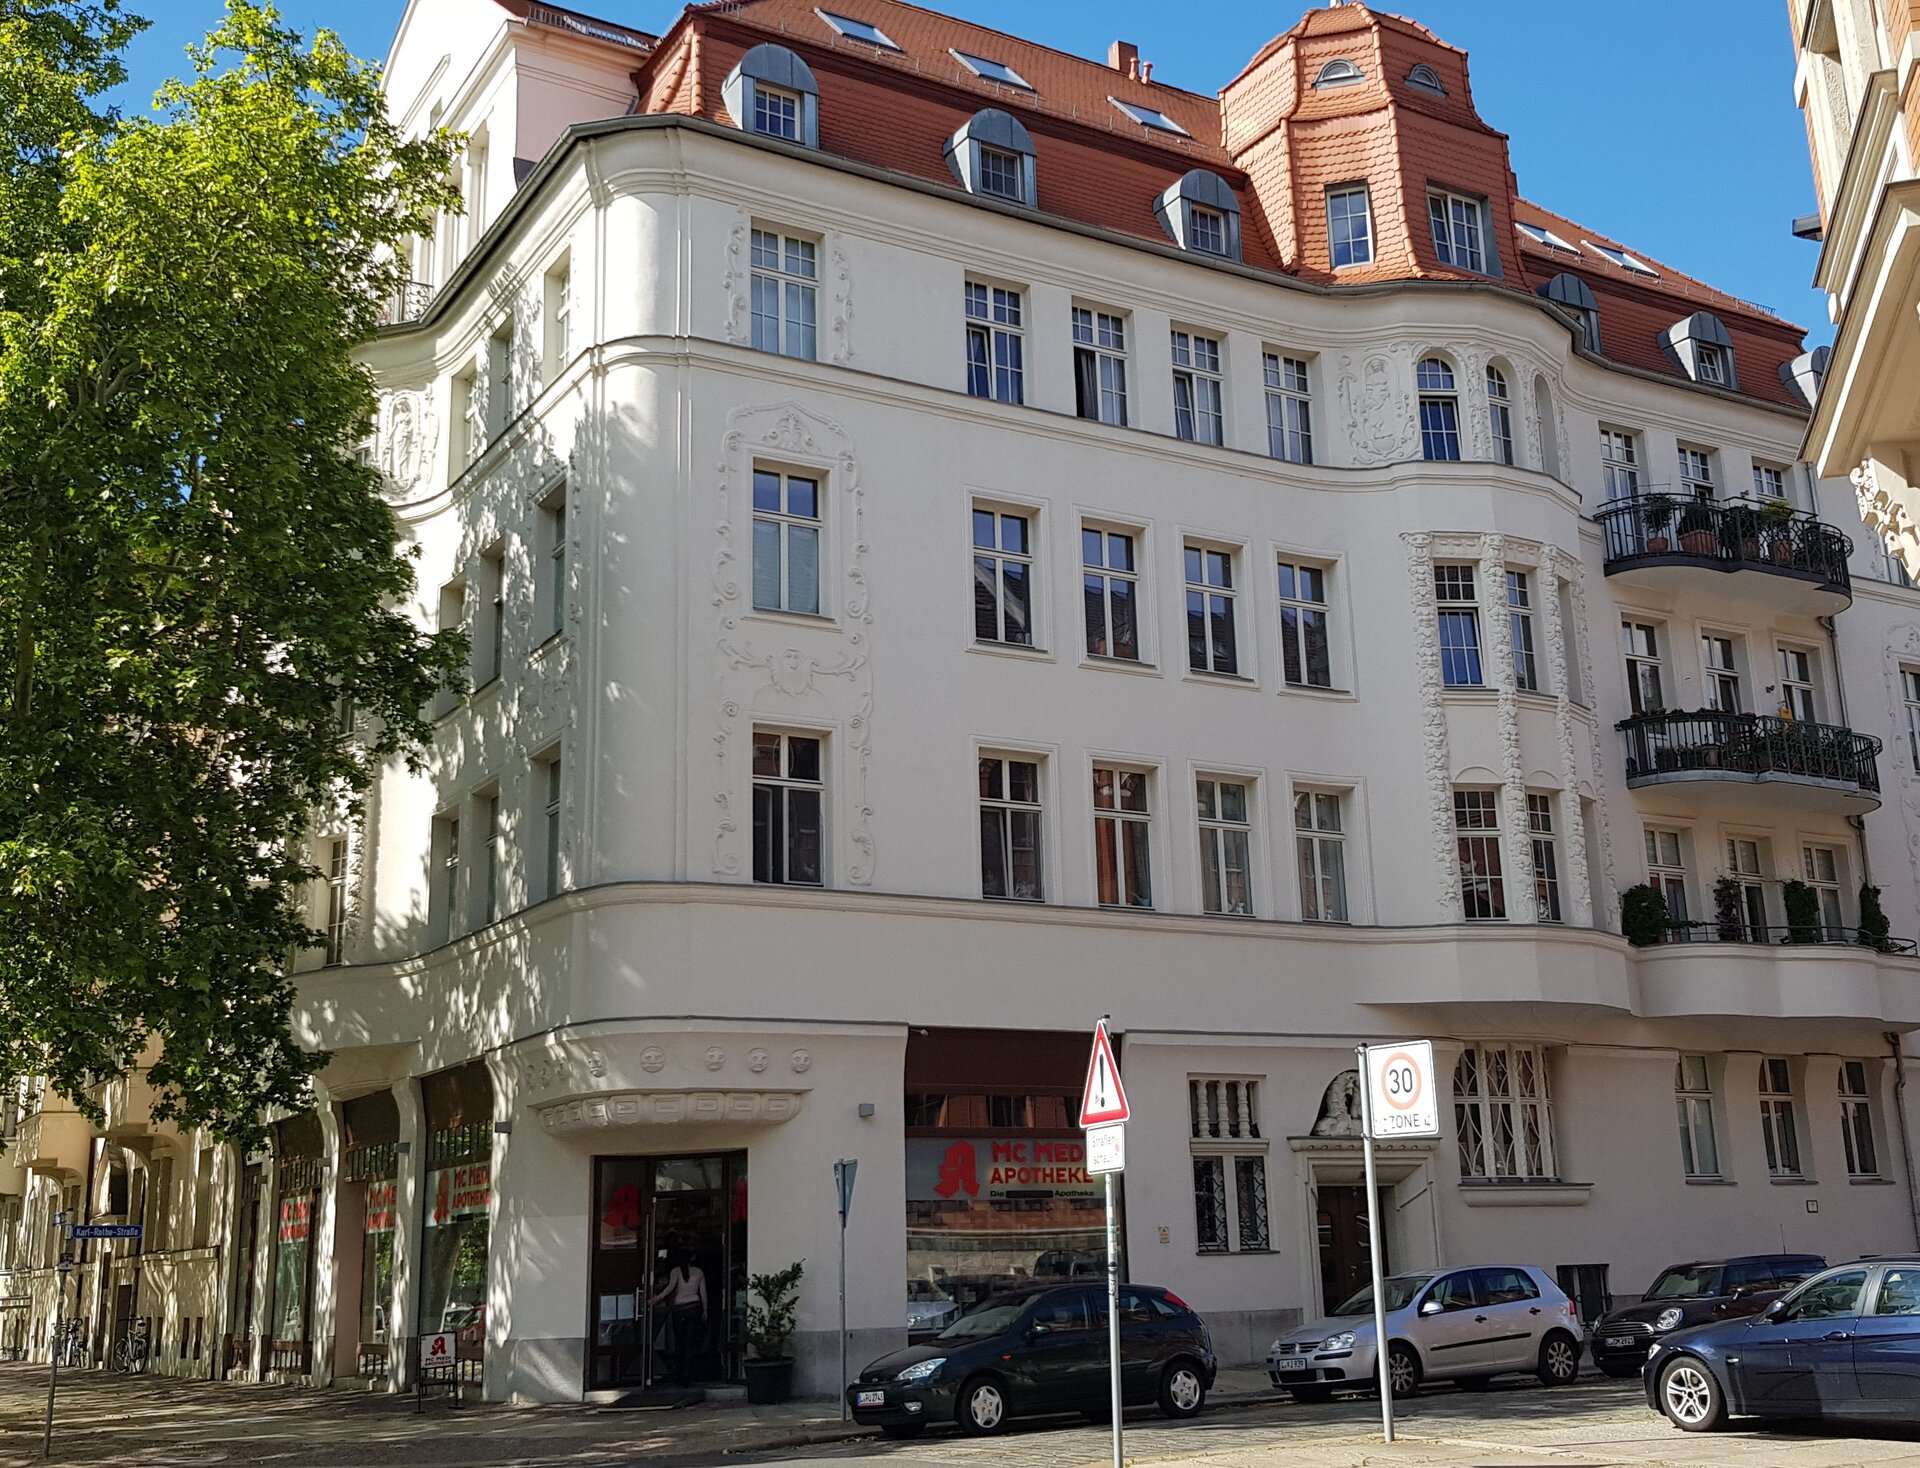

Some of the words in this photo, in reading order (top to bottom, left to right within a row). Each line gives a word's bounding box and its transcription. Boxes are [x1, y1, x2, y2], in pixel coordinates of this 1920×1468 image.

[1389, 1067, 1413, 1094] 30
[1389, 1113, 1420, 1129] ZONE
[991, 1140, 1027, 1163] MC
[1033, 1139, 1085, 1163] MED
[990, 1166, 1094, 1184] APOTHEKE
[1054, 1189, 1095, 1198] Apotheke
[76, 1227, 139, 1236] Karl-Rothe-Straße
